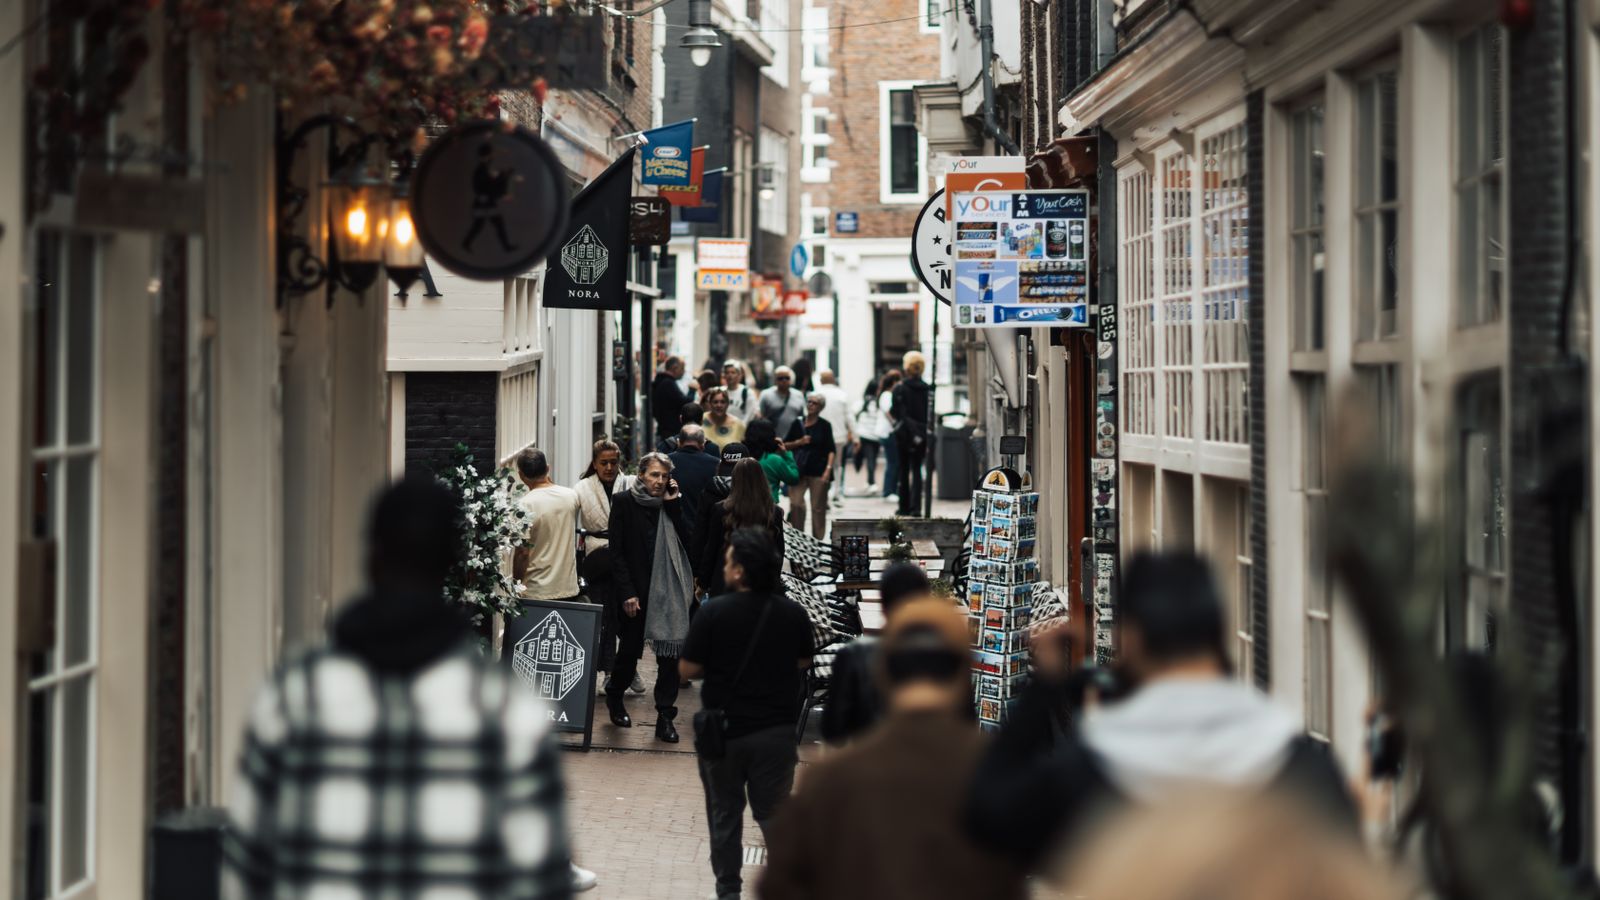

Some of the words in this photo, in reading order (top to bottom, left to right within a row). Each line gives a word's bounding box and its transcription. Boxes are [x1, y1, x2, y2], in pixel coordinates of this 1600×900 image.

[646, 158, 688, 170] Macaroni
[654, 167, 687, 178] Cheese
[703, 274, 743, 285] ATM
[568, 290, 600, 298] NORA
